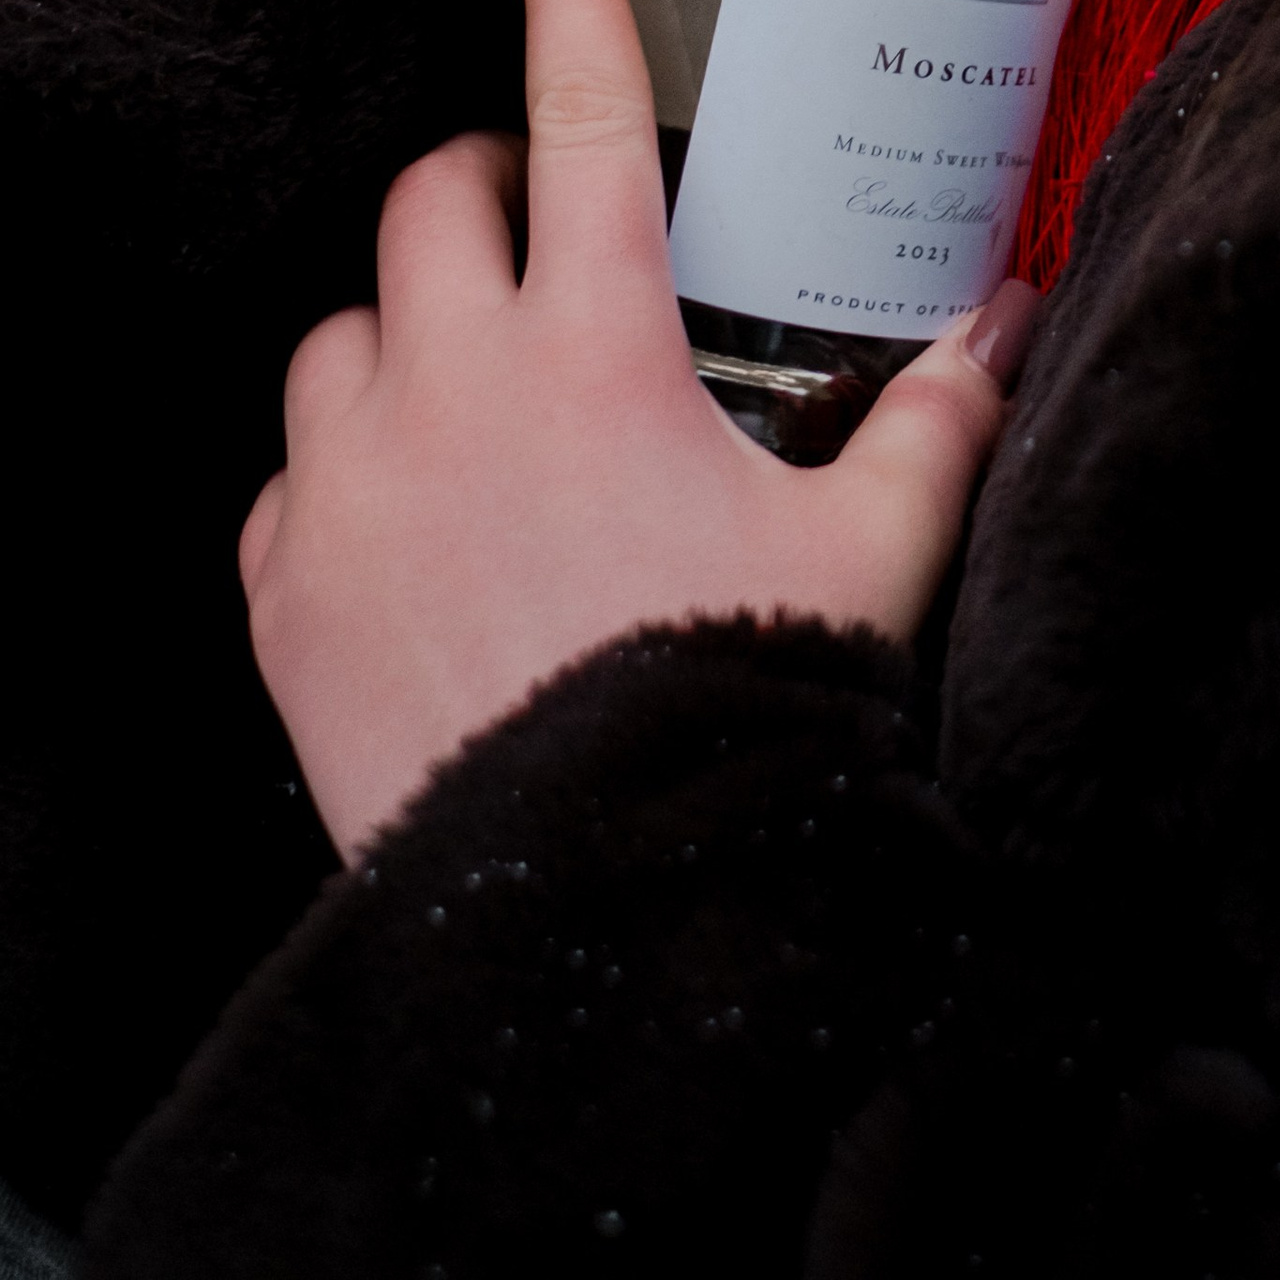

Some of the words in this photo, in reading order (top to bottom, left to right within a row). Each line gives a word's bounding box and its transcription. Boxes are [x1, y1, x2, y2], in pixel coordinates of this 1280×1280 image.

[870, 42, 1037, 87] MOSCATEL
[833, 134, 924, 163] MEDIUM
[933, 148, 988, 168] SWEET
[845, 176, 920, 220] Estate
[924, 187, 1003, 224] Bottled
[895, 243, 951, 266] 2023
[797, 289, 905, 314] PRODUCT
[916, 304, 940, 317] OF
[947, 304, 974, 317] SPA
